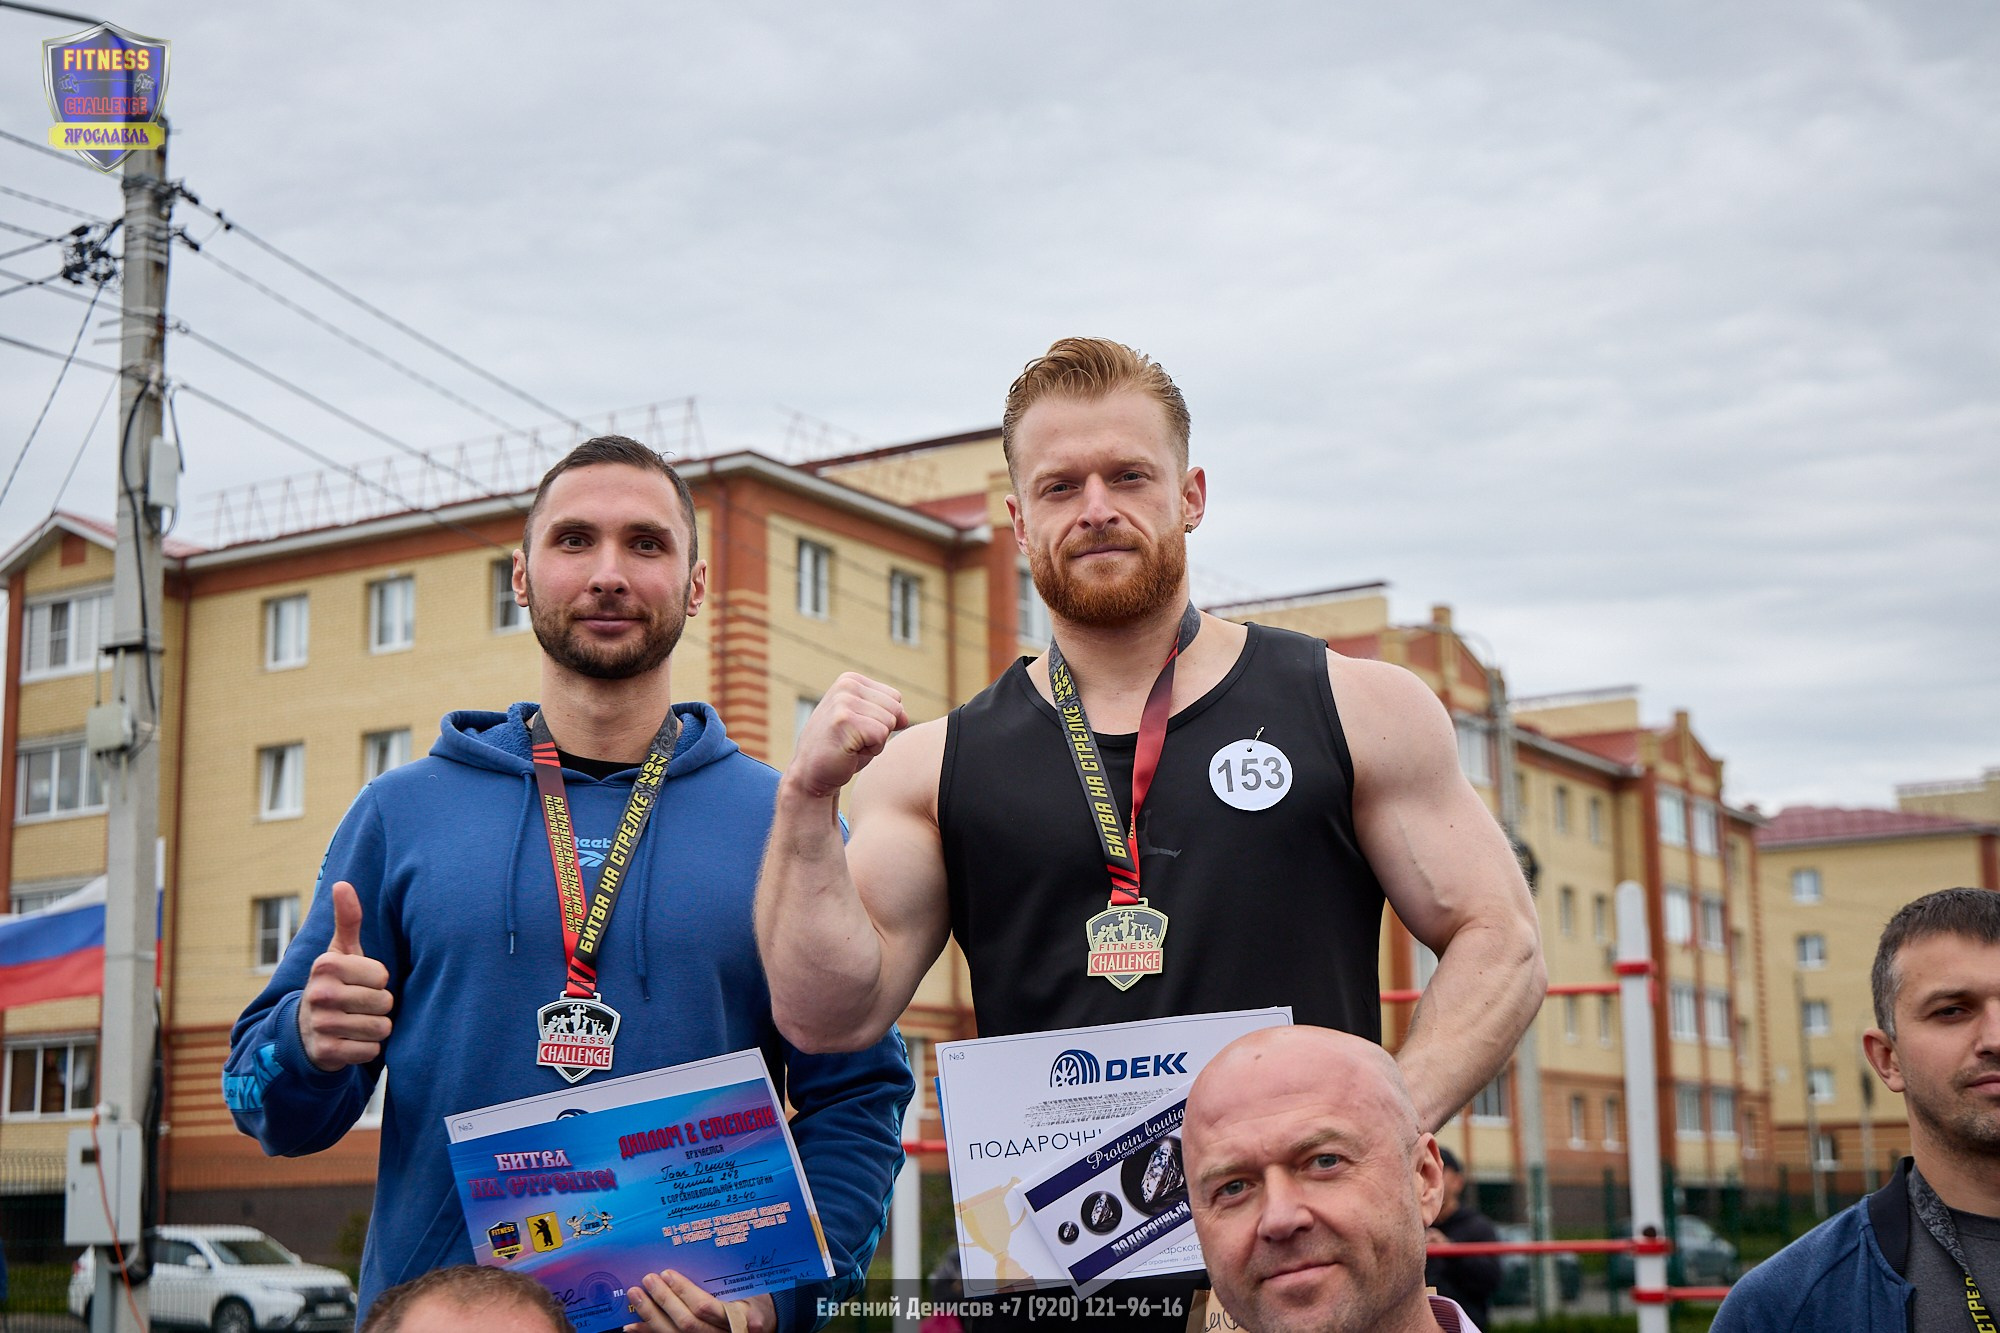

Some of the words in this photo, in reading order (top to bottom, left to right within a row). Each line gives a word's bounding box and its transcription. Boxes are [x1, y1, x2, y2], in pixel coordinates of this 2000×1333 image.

[1053, 664, 1066, 682] 17
[1054, 674, 1069, 692] 08
[1057, 687, 1073, 703] 24
[1063, 704, 1100, 772] СТРЕЛКЕ
[643, 762, 664, 776] 08
[650, 752, 668, 766] 17
[1218, 756, 1285, 793] 153
[638, 772, 660, 788] 24
[1086, 776, 1108, 799] НА
[544, 794, 560, 834] ОБЛАСТИ
[1094, 802, 1128, 859] БИТВА
[551, 833, 571, 897] ЯРОСЛАВСКОЙ
[553, 796, 584, 916] ФИТНЕС-ЧЕЛЛЕНДЖУ
[579, 893, 611, 954] БИТВА
[599, 866, 620, 894] НА
[610, 791, 650, 868] СТРЕЛКЕ
[564, 899, 576, 932] КУБОК
[1092, 953, 1159, 971] CHALLENGE
[1099, 941, 1153, 951] FITNESS
[541, 1045, 610, 1065] CHALLENGE
[549, 1034, 605, 1045] FITNESS
[619, 1124, 684, 1160] ДИПЛОМ
[685, 1122, 698, 1143] 2
[699, 1105, 777, 1140] СТЕПЕНИ
[969, 1128, 1102, 1160] ПОДАРОЧН
[1121, 1136, 1155, 1159] спортивное
[1154, 1122, 1179, 1139] питание
[494, 1149, 572, 1172] БИТВА
[1086, 1132, 1143, 1170] Protein
[1110, 1200, 1191, 1257] ПОДАРОЧНЫЙ
